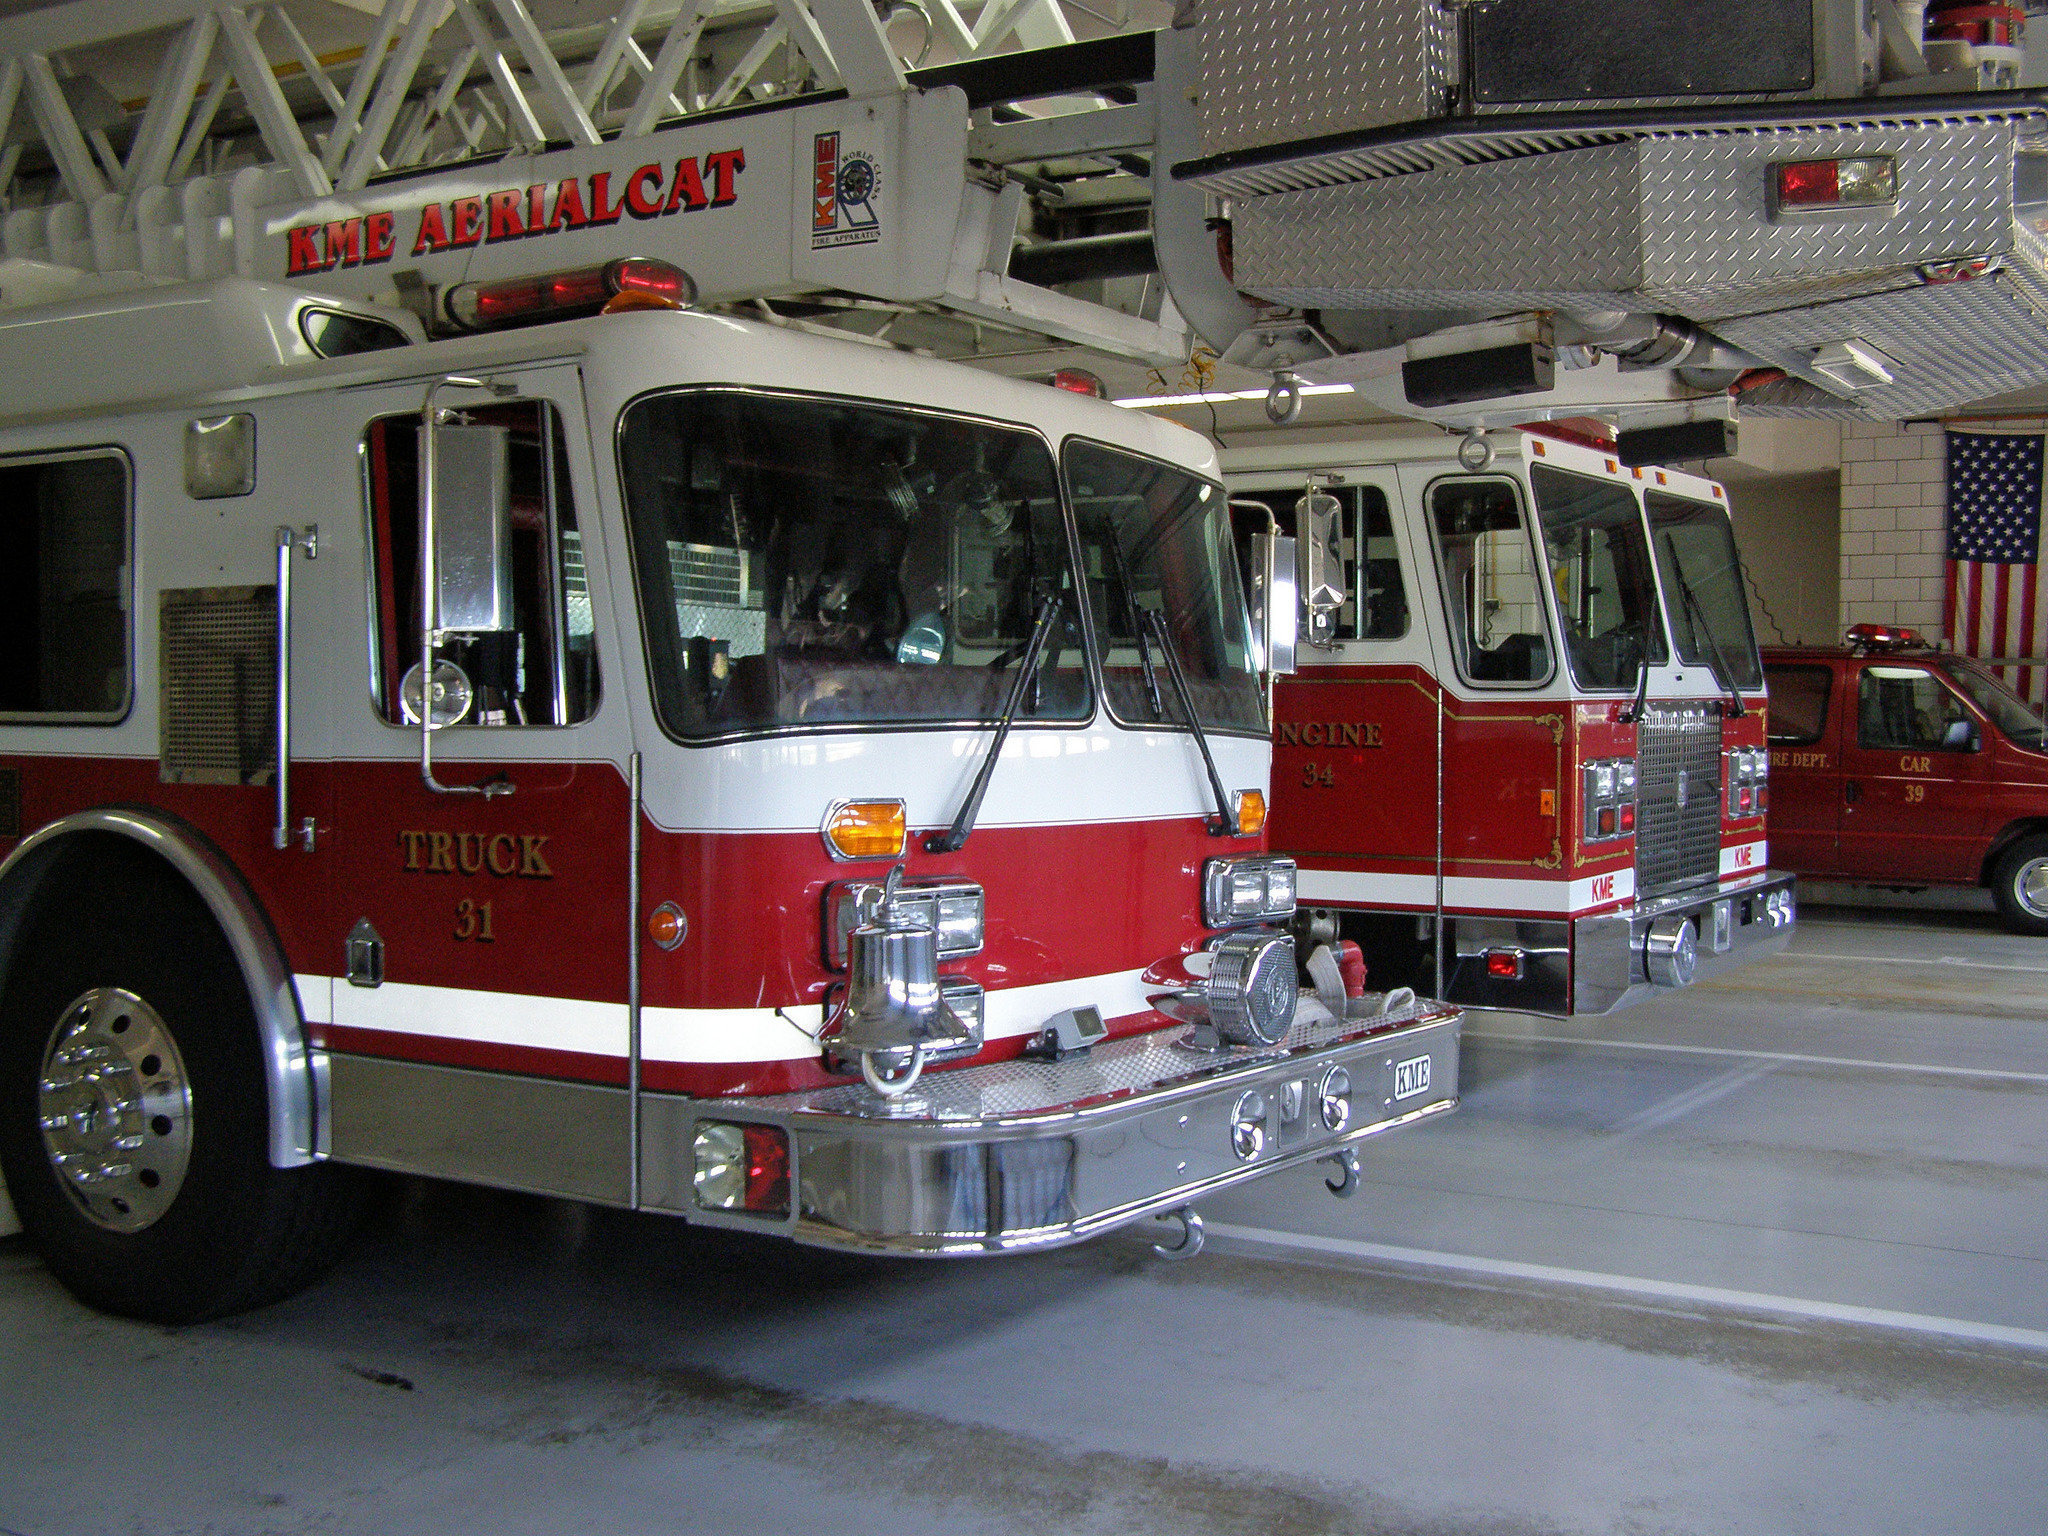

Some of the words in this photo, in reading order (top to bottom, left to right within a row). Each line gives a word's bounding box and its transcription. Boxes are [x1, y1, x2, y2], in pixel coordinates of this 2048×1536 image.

[841, 150, 875, 164] WORLD
[815, 136, 837, 226] KME
[286, 211, 396, 278] KME
[1273, 721, 1382, 748] NGINE
[1768, 751, 1789, 767] IRE
[1792, 752, 1830, 768] DEPT.
[1900, 755, 1931, 773] CAR
[1302, 761, 1335, 788] 34
[1905, 784, 1925, 803] 39
[397, 830, 554, 880] TRUCK
[1734, 846, 1752, 869] KME
[1591, 875, 1615, 903] KME
[453, 899, 495, 943] 31
[1397, 1059, 1429, 1096] KME
